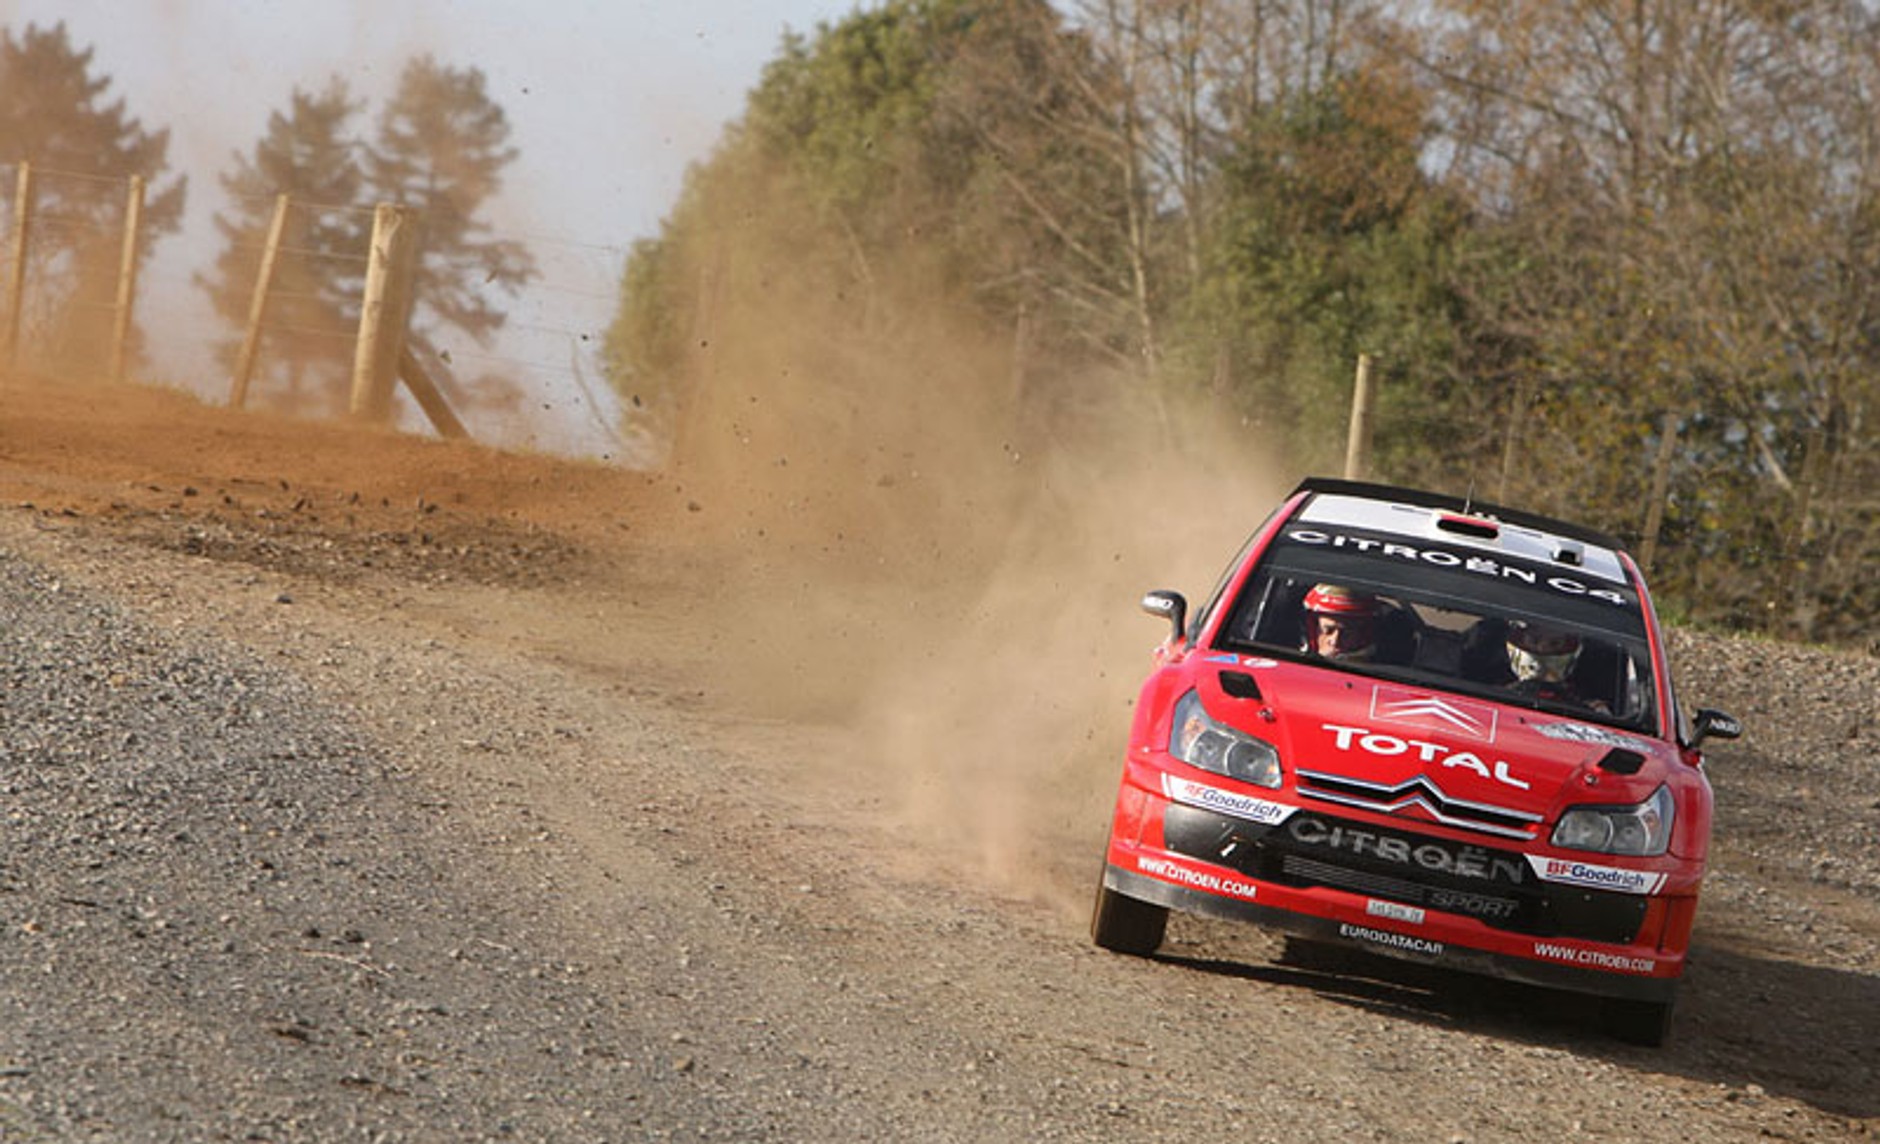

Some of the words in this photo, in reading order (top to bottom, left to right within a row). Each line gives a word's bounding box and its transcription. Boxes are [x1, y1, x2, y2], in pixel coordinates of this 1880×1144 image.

[1288, 529, 1536, 584] CITROËN
[1548, 577, 1627, 605] C4
[1321, 724, 1530, 790] TOTAL
[1289, 817, 1524, 884] CITROËN
[1546, 861, 1644, 887] BFGoodrich
[1340, 923, 1444, 955] EURODATACAR
[1534, 942, 1655, 972] WWW.CITROEN.COM
